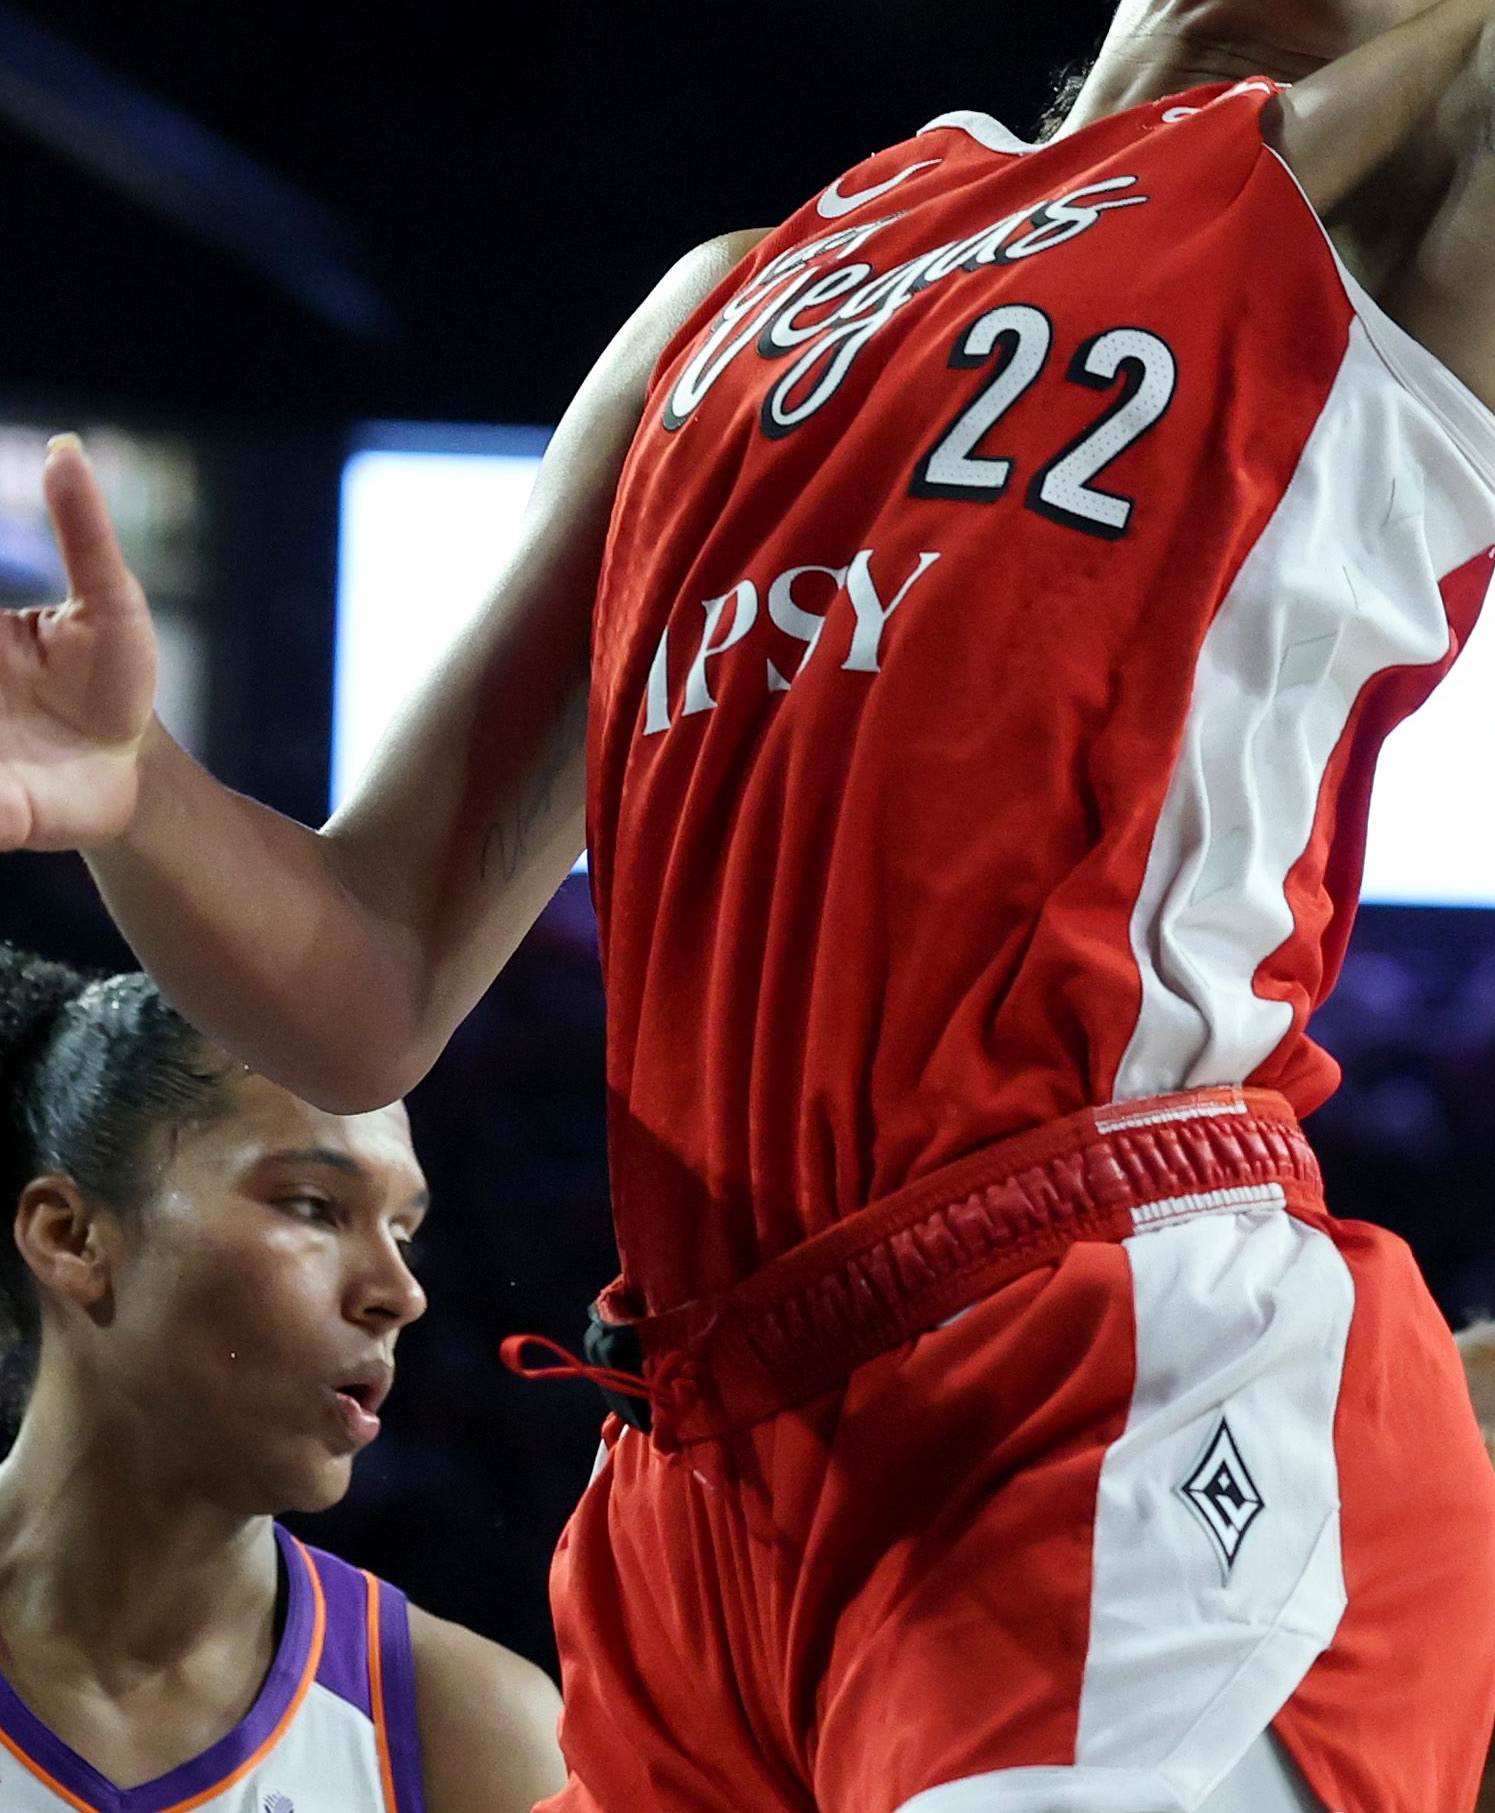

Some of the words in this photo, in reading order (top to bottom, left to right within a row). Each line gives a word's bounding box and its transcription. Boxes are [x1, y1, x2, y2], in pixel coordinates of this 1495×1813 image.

[662, 175, 1150, 440] Vegas
[907, 302, 1178, 541] 22
[642, 548, 942, 735] IPSY
